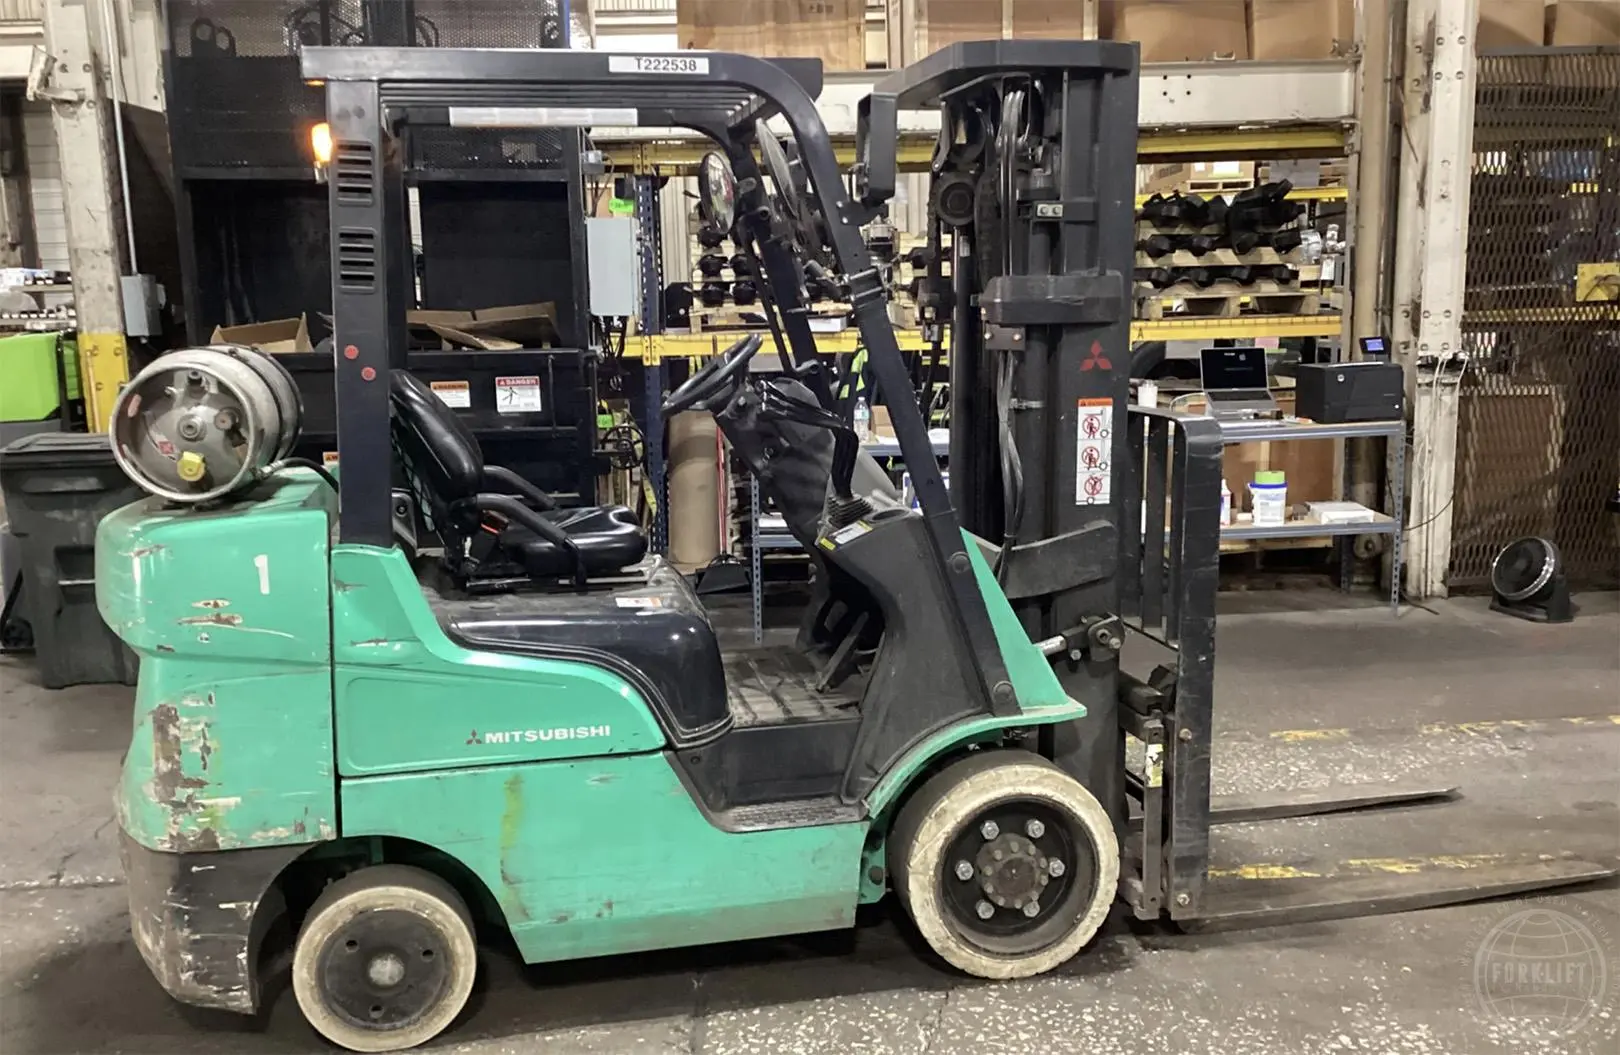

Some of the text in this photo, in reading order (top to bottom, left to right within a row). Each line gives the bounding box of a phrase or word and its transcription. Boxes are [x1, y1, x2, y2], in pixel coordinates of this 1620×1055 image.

[634, 57, 697, 72] T222538
[253, 553, 271, 596] 1
[484, 725, 611, 744] MITSUBISHI
